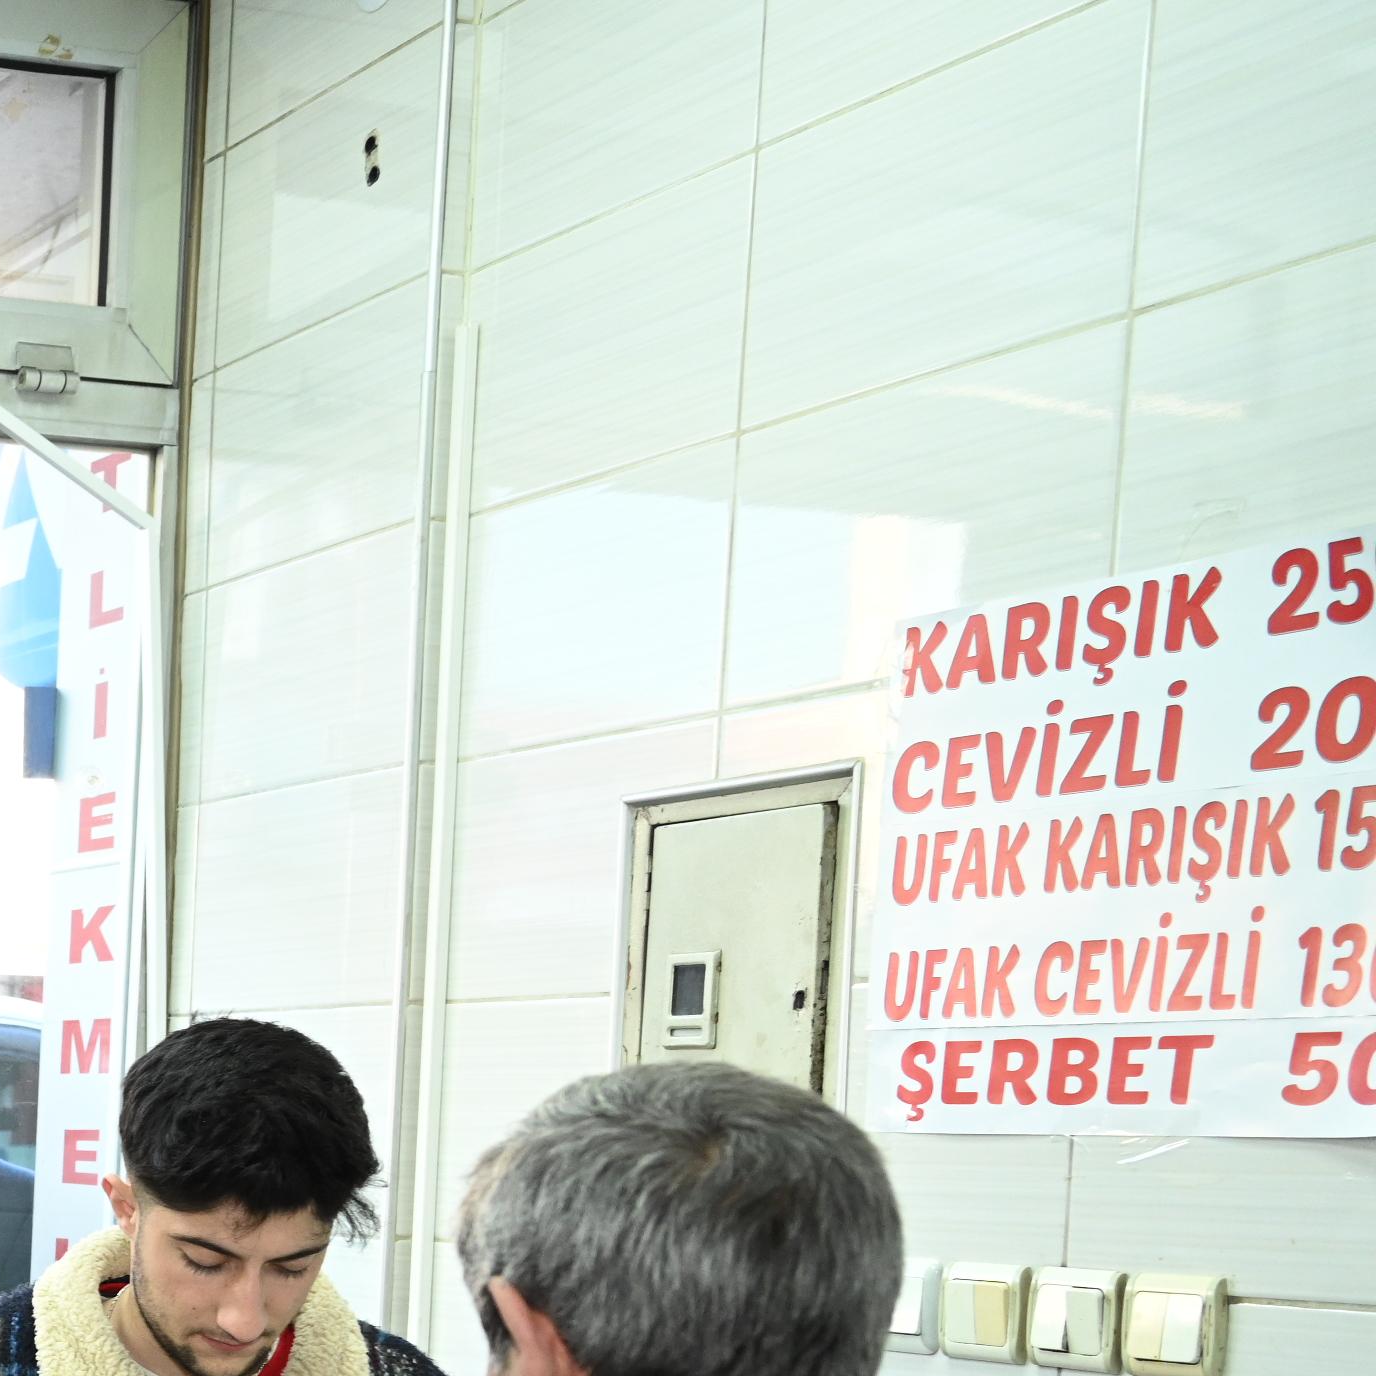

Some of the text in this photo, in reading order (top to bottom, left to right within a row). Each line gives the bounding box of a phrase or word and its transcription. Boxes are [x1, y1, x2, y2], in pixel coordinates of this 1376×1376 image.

[903, 536, 1376, 698] KARIŞIK 25
[892, 679, 1188, 814] CEVİZLİ
[890, 821, 1030, 907] UFAK
[1043, 792, 1297, 904] KARIŞIK
[883, 905, 1376, 1022] UFAK CEVİZLİ 13
[896, 1034, 1214, 1122] ŞERBET
